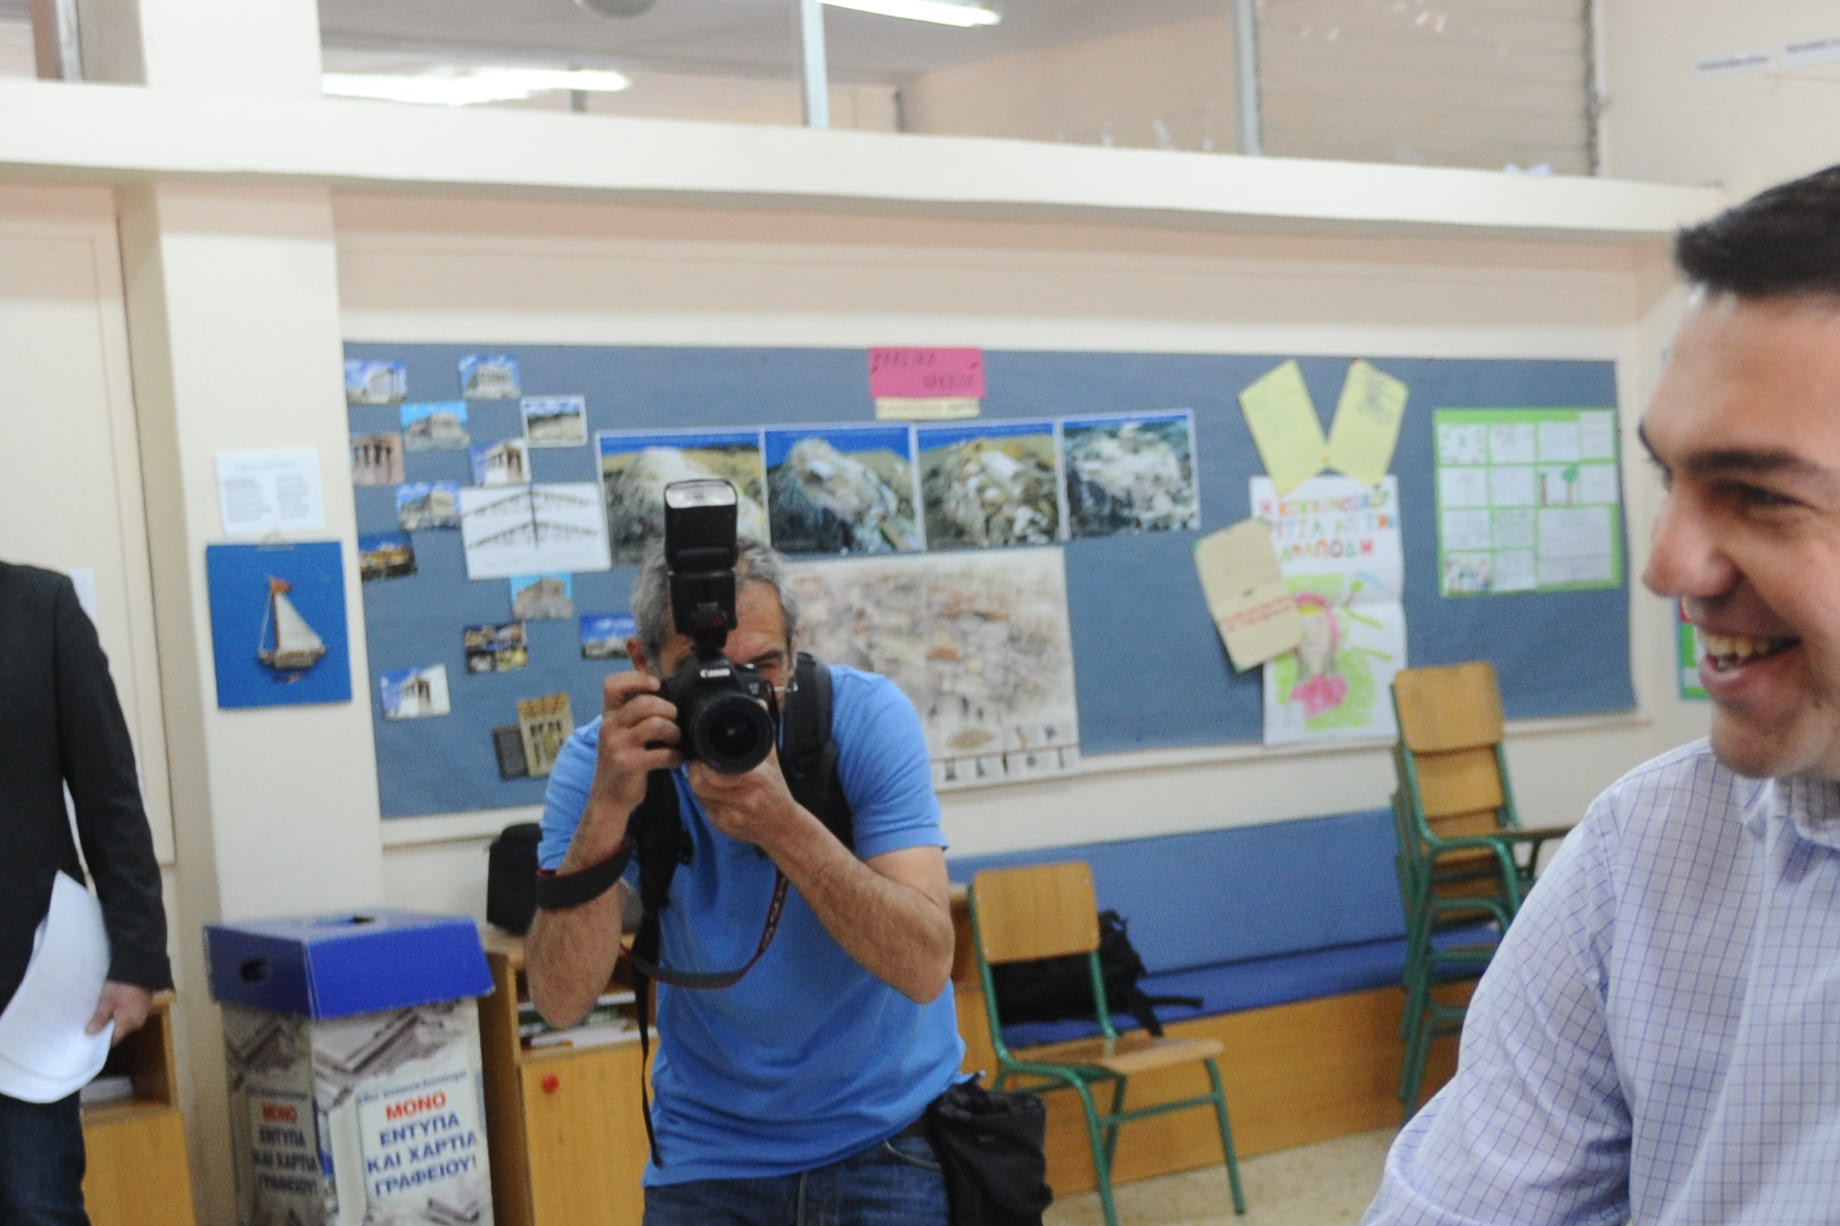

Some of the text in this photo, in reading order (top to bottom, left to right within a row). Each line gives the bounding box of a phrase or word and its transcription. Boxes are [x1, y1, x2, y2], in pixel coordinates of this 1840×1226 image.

[386, 1091, 447, 1121] ΜΟΝΟ
[380, 1112, 460, 1147] ΕΝΤΥΠΑ
[367, 1130, 478, 1175] ΚΑΙ ΧΑΡΤΙΑ
[375, 1153, 478, 1198] ΓΡΑΦΕΙΟΥ!
